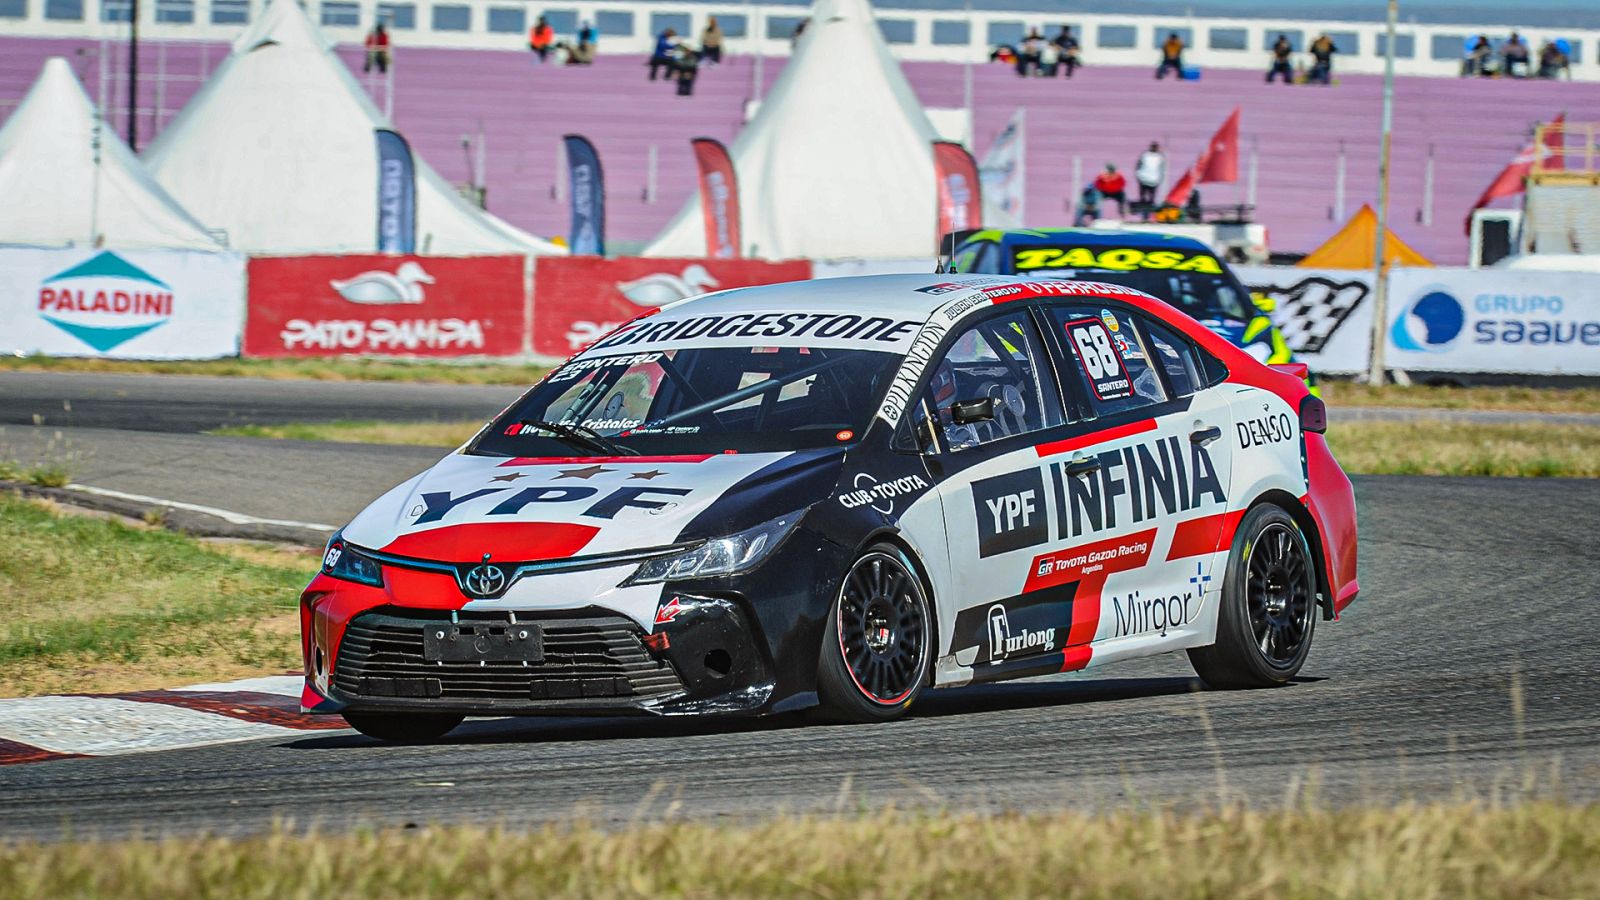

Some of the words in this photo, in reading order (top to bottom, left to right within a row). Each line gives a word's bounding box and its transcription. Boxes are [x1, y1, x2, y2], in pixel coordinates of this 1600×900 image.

[1015, 248, 1223, 274] TAQSA
[38, 287, 174, 316] PALADINI
[1475, 294, 1564, 315] GRUPO
[280, 319, 365, 350] PATO
[366, 318, 485, 350] PAMPA
[591, 313, 925, 350] BRIDGESTONE
[563, 353, 664, 371] SANTERO
[886, 321, 947, 412] PILKINGTON
[1073, 325, 1119, 380] 68
[1097, 380, 1129, 393] SANTERO
[581, 417, 641, 430] Cristales
[1236, 413, 1292, 449] DENSO
[1050, 436, 1227, 541] INFINIA
[412, 486, 693, 526] YPF
[985, 489, 1036, 534] YPF
[325, 548, 342, 567] 68
[1038, 562, 1053, 575] GR
[1055, 555, 1087, 571] TOYOTA
[1088, 549, 1116, 563] GAZOO
[1118, 542, 1147, 557] Racing
[1113, 591, 1191, 637] Mirgor
[990, 613, 1056, 656] Furlong
